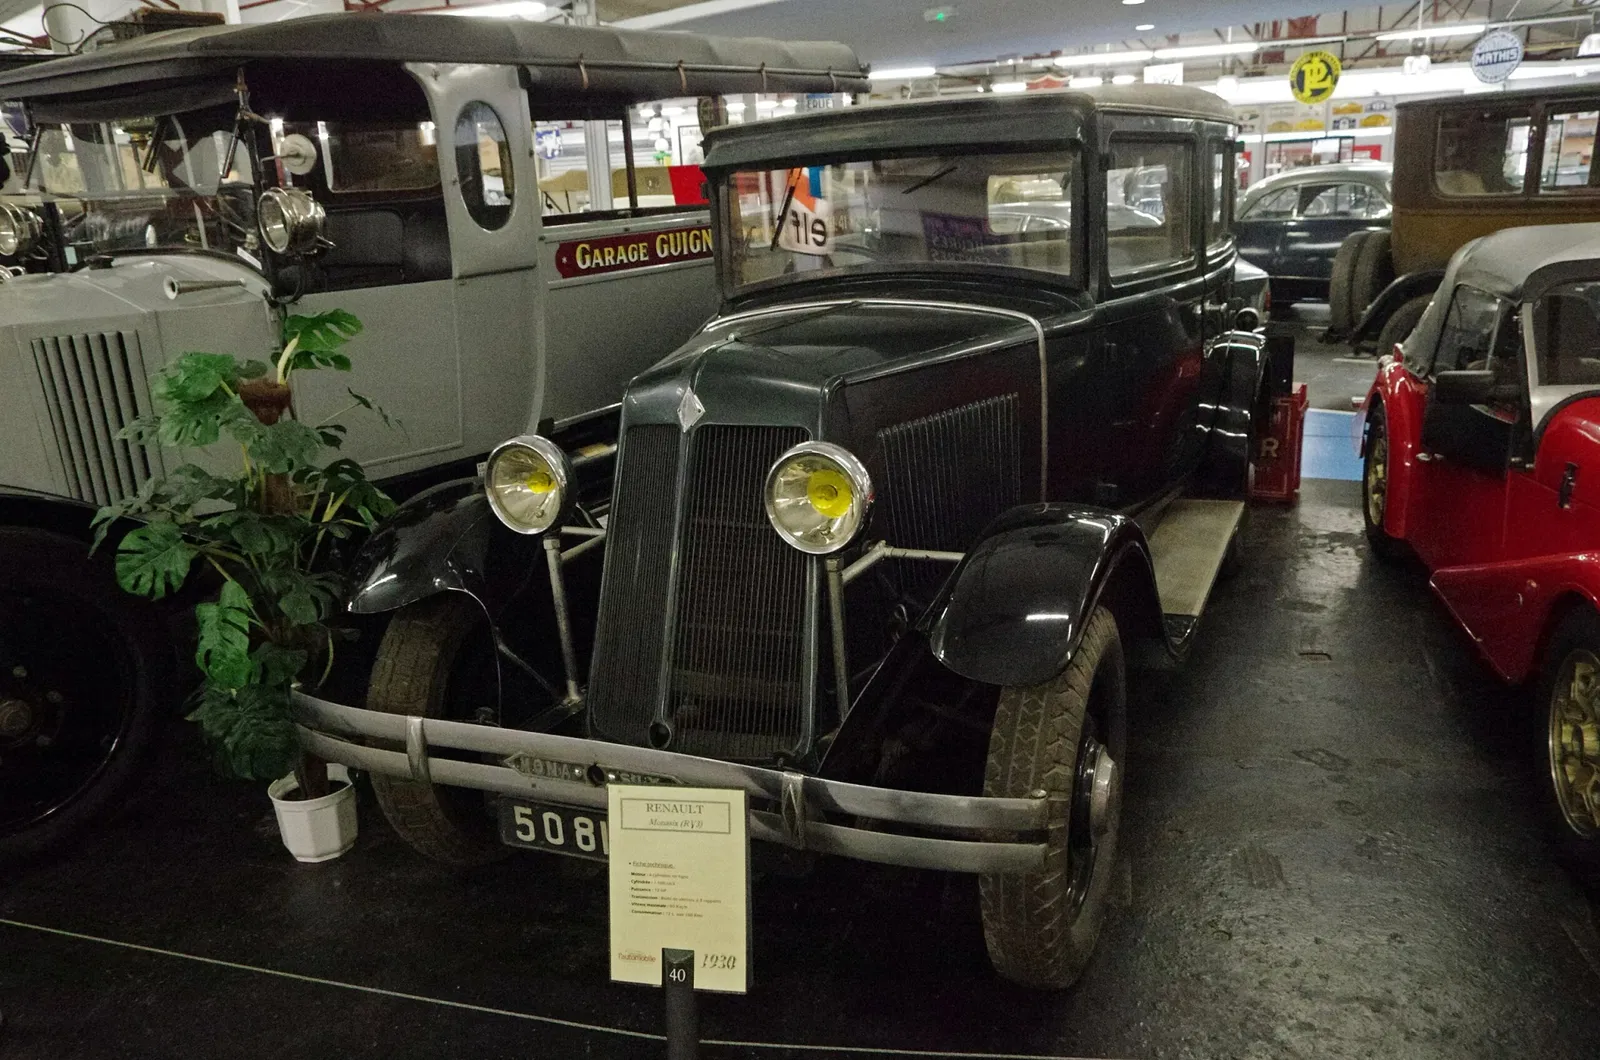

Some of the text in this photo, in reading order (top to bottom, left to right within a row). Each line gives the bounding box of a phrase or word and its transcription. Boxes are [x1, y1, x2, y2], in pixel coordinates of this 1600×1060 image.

[1475, 48, 1517, 66] MATHIS
[575, 242, 649, 270] GARAGE
[520, 756, 571, 781] MONA
[645, 803, 704, 815] RENAULT
[649, 818, 679, 828] Monasix
[701, 953, 738, 970] 1930
[669, 968, 686, 982] 40
